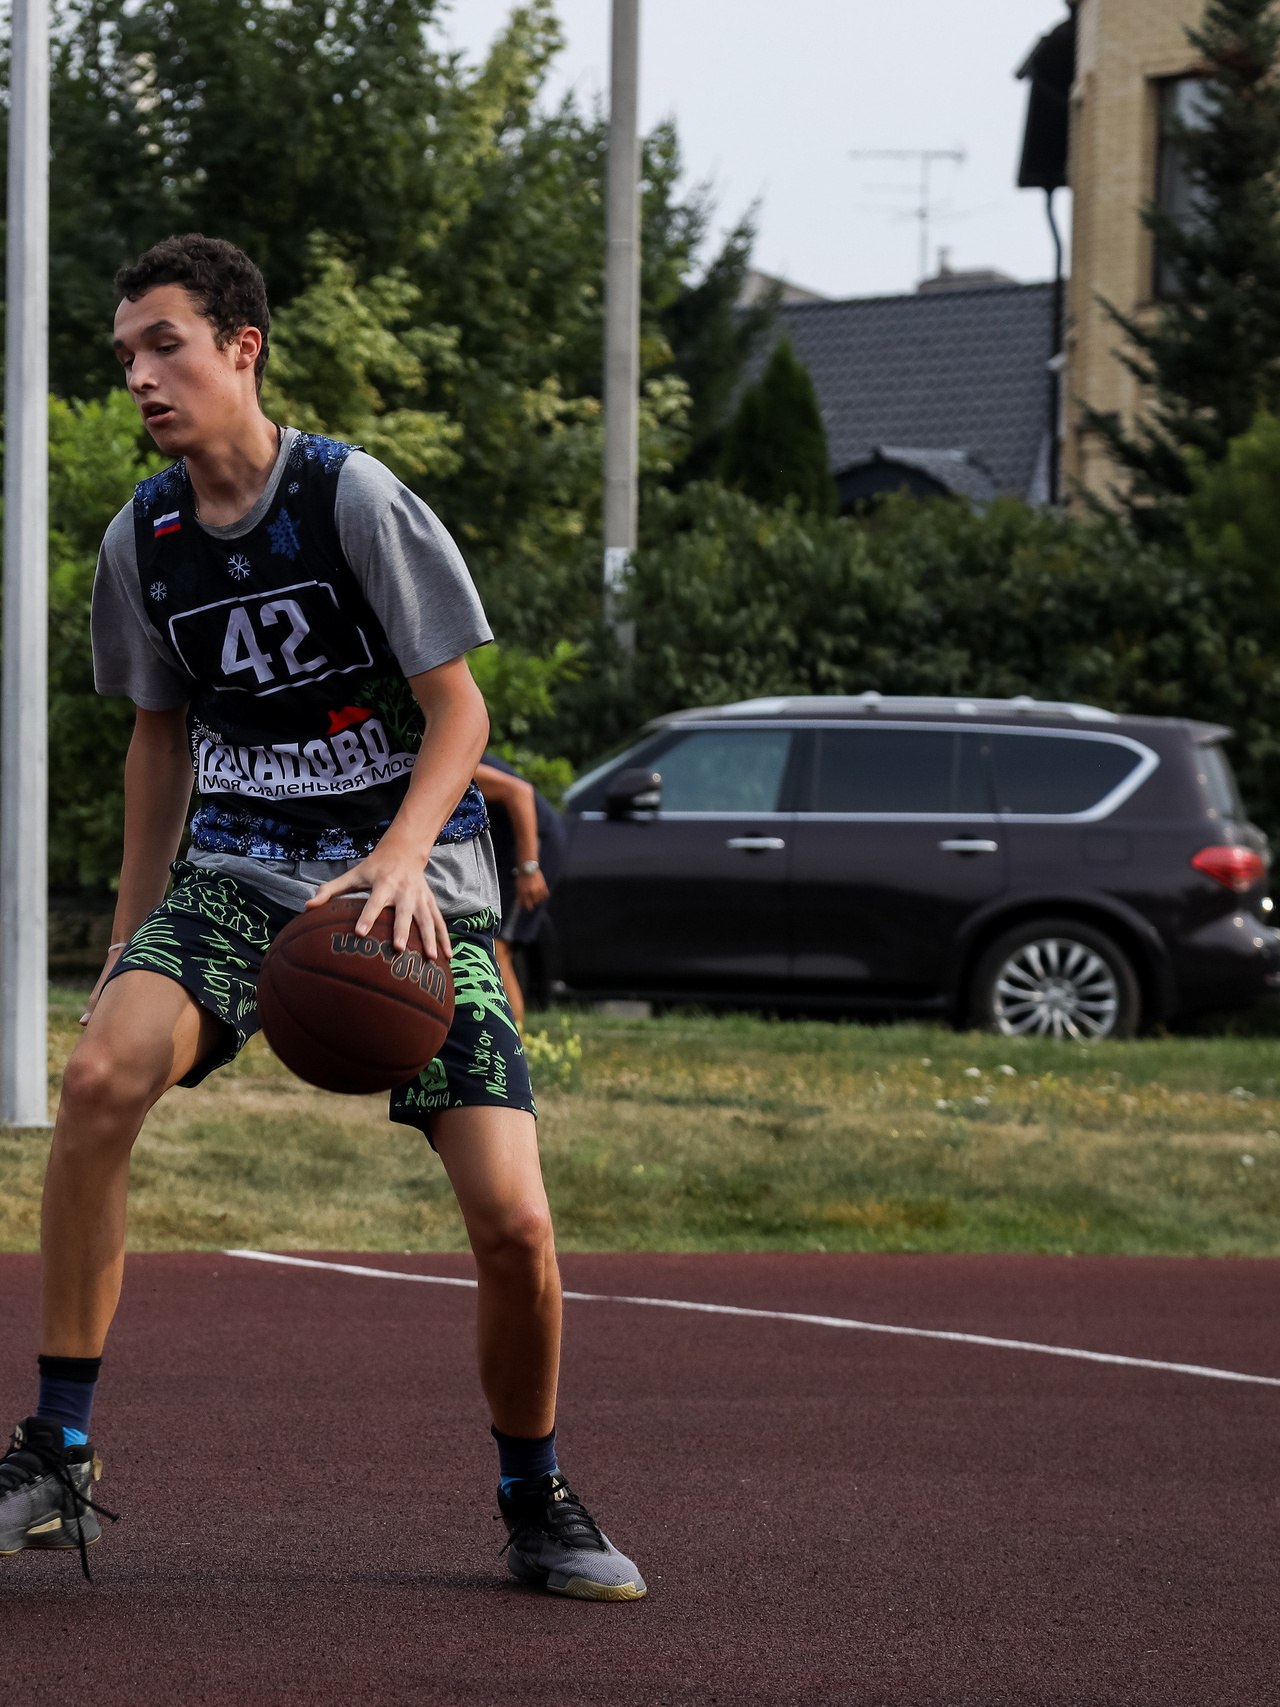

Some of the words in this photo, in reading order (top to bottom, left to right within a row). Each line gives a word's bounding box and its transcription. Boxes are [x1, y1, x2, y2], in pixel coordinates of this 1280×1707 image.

[221, 599, 328, 684] 42
[203, 774, 241, 792] Моя
[247, 774, 366, 797] маленькая
[371, 757, 417, 781] Мос
[236, 996, 258, 1021] Neve
[478, 1029, 494, 1047] or
[485, 1050, 509, 1100] Never
